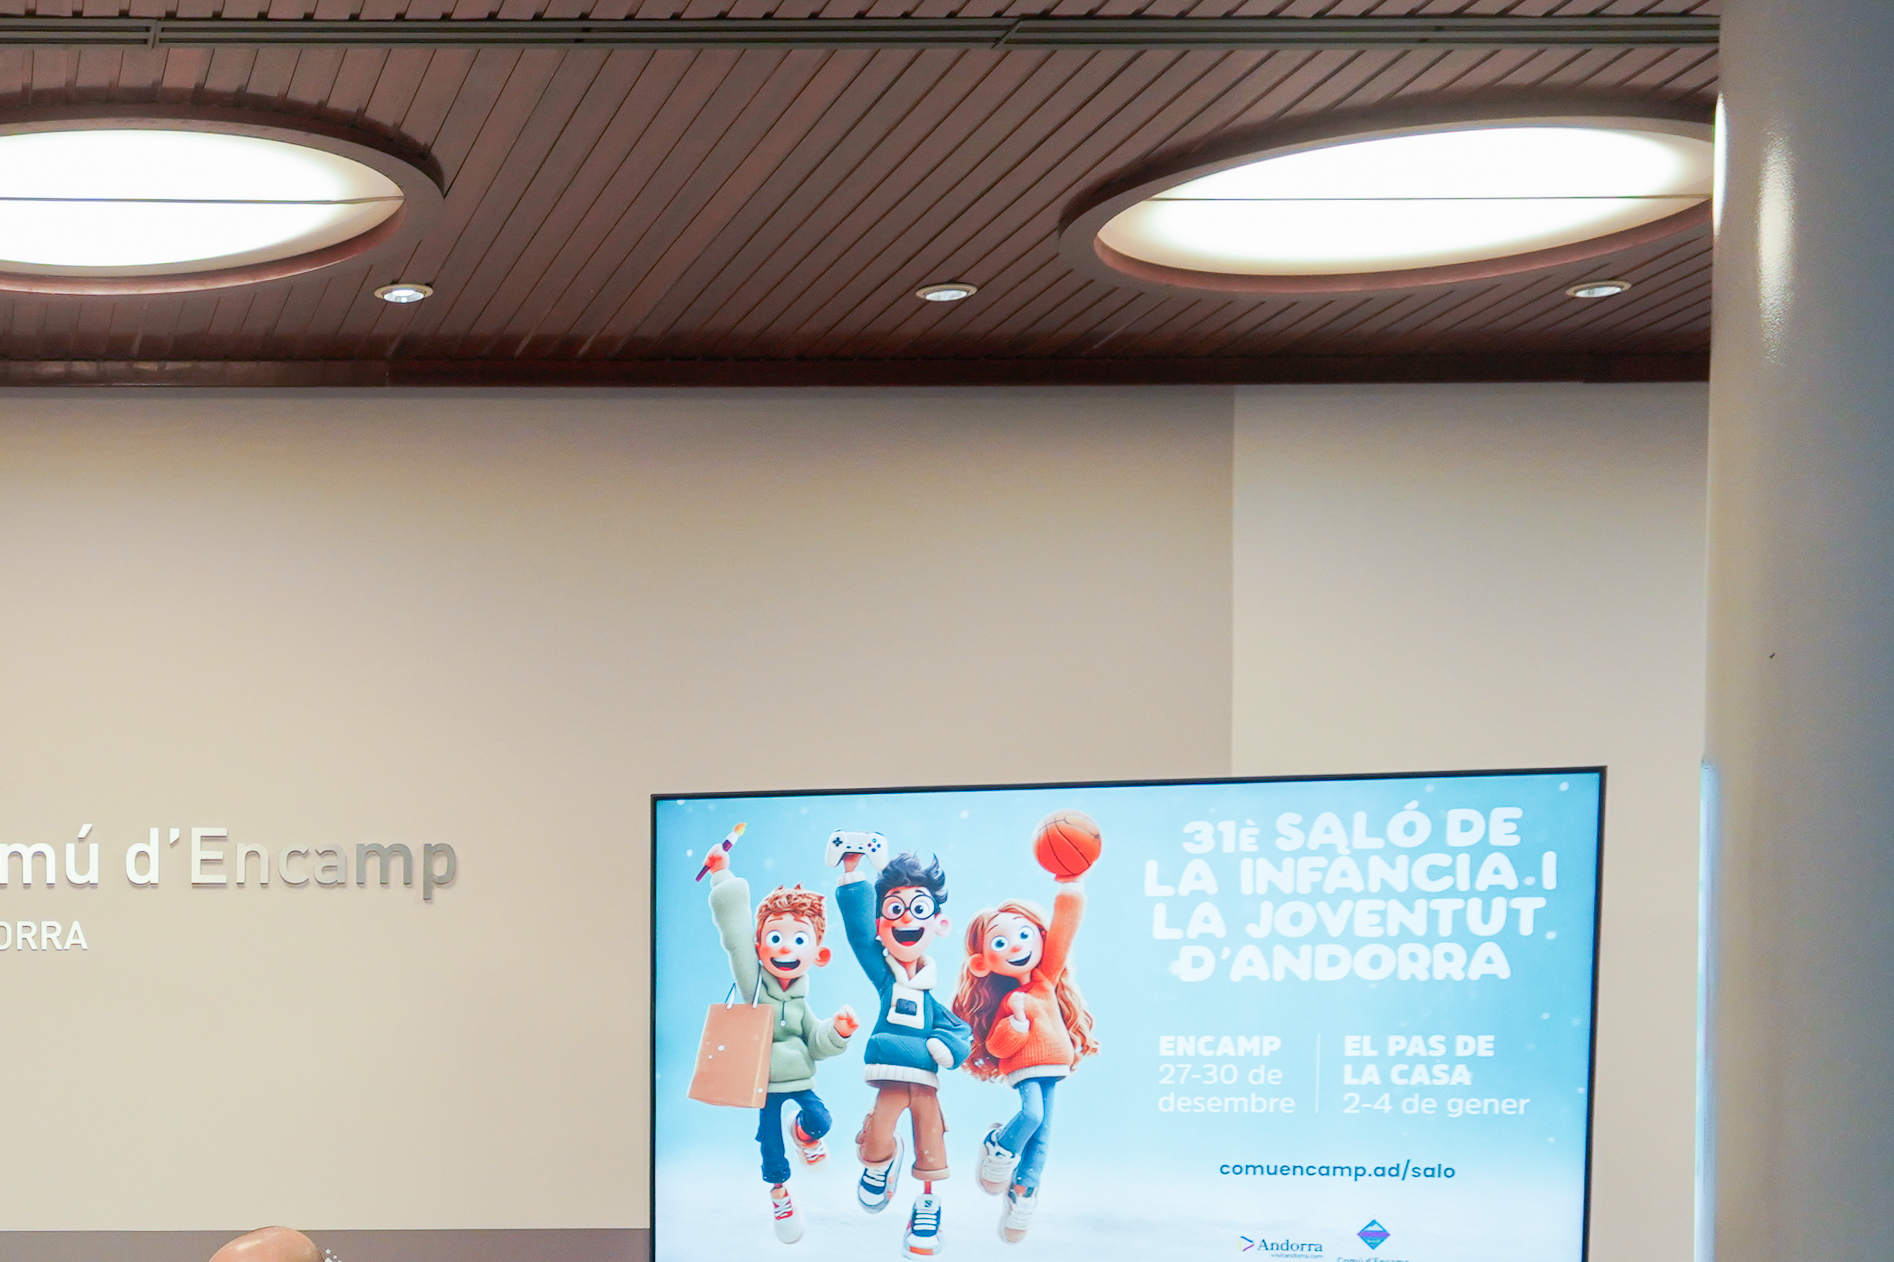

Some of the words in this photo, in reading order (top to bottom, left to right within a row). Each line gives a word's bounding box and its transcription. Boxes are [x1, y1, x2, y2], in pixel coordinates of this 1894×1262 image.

[1274, 800, 1433, 851] SALÓ
[1446, 806, 1524, 848] DE
[125, 825, 459, 902] d'Encamp
[1144, 858, 1219, 897] LA
[1541, 850, 1558, 891] I
[1152, 901, 1227, 940] LA
[1245, 896, 1547, 940] JOVENTUT
[1178, 941, 1512, 983] D'ANDORRA
[1158, 1034, 1282, 1057] ENCAMP
[1343, 1034, 1379, 1057] EL
[1388, 1034, 1447, 1057] PAS
[1454, 1034, 1496, 1057] DE
[1158, 1063, 1239, 1086] 27-30
[1248, 1063, 1283, 1085] de
[1342, 1063, 1383, 1086] LA
[1390, 1063, 1474, 1087] CASA
[1157, 1092, 1296, 1114] desembre
[1342, 1092, 1393, 1115] 2-4
[1402, 1092, 1438, 1115] de
[1446, 1096, 1531, 1118] gener
[1219, 1159, 1456, 1182] comuencamp.ad/salo
[1257, 1238, 1323, 1252] Andorra
